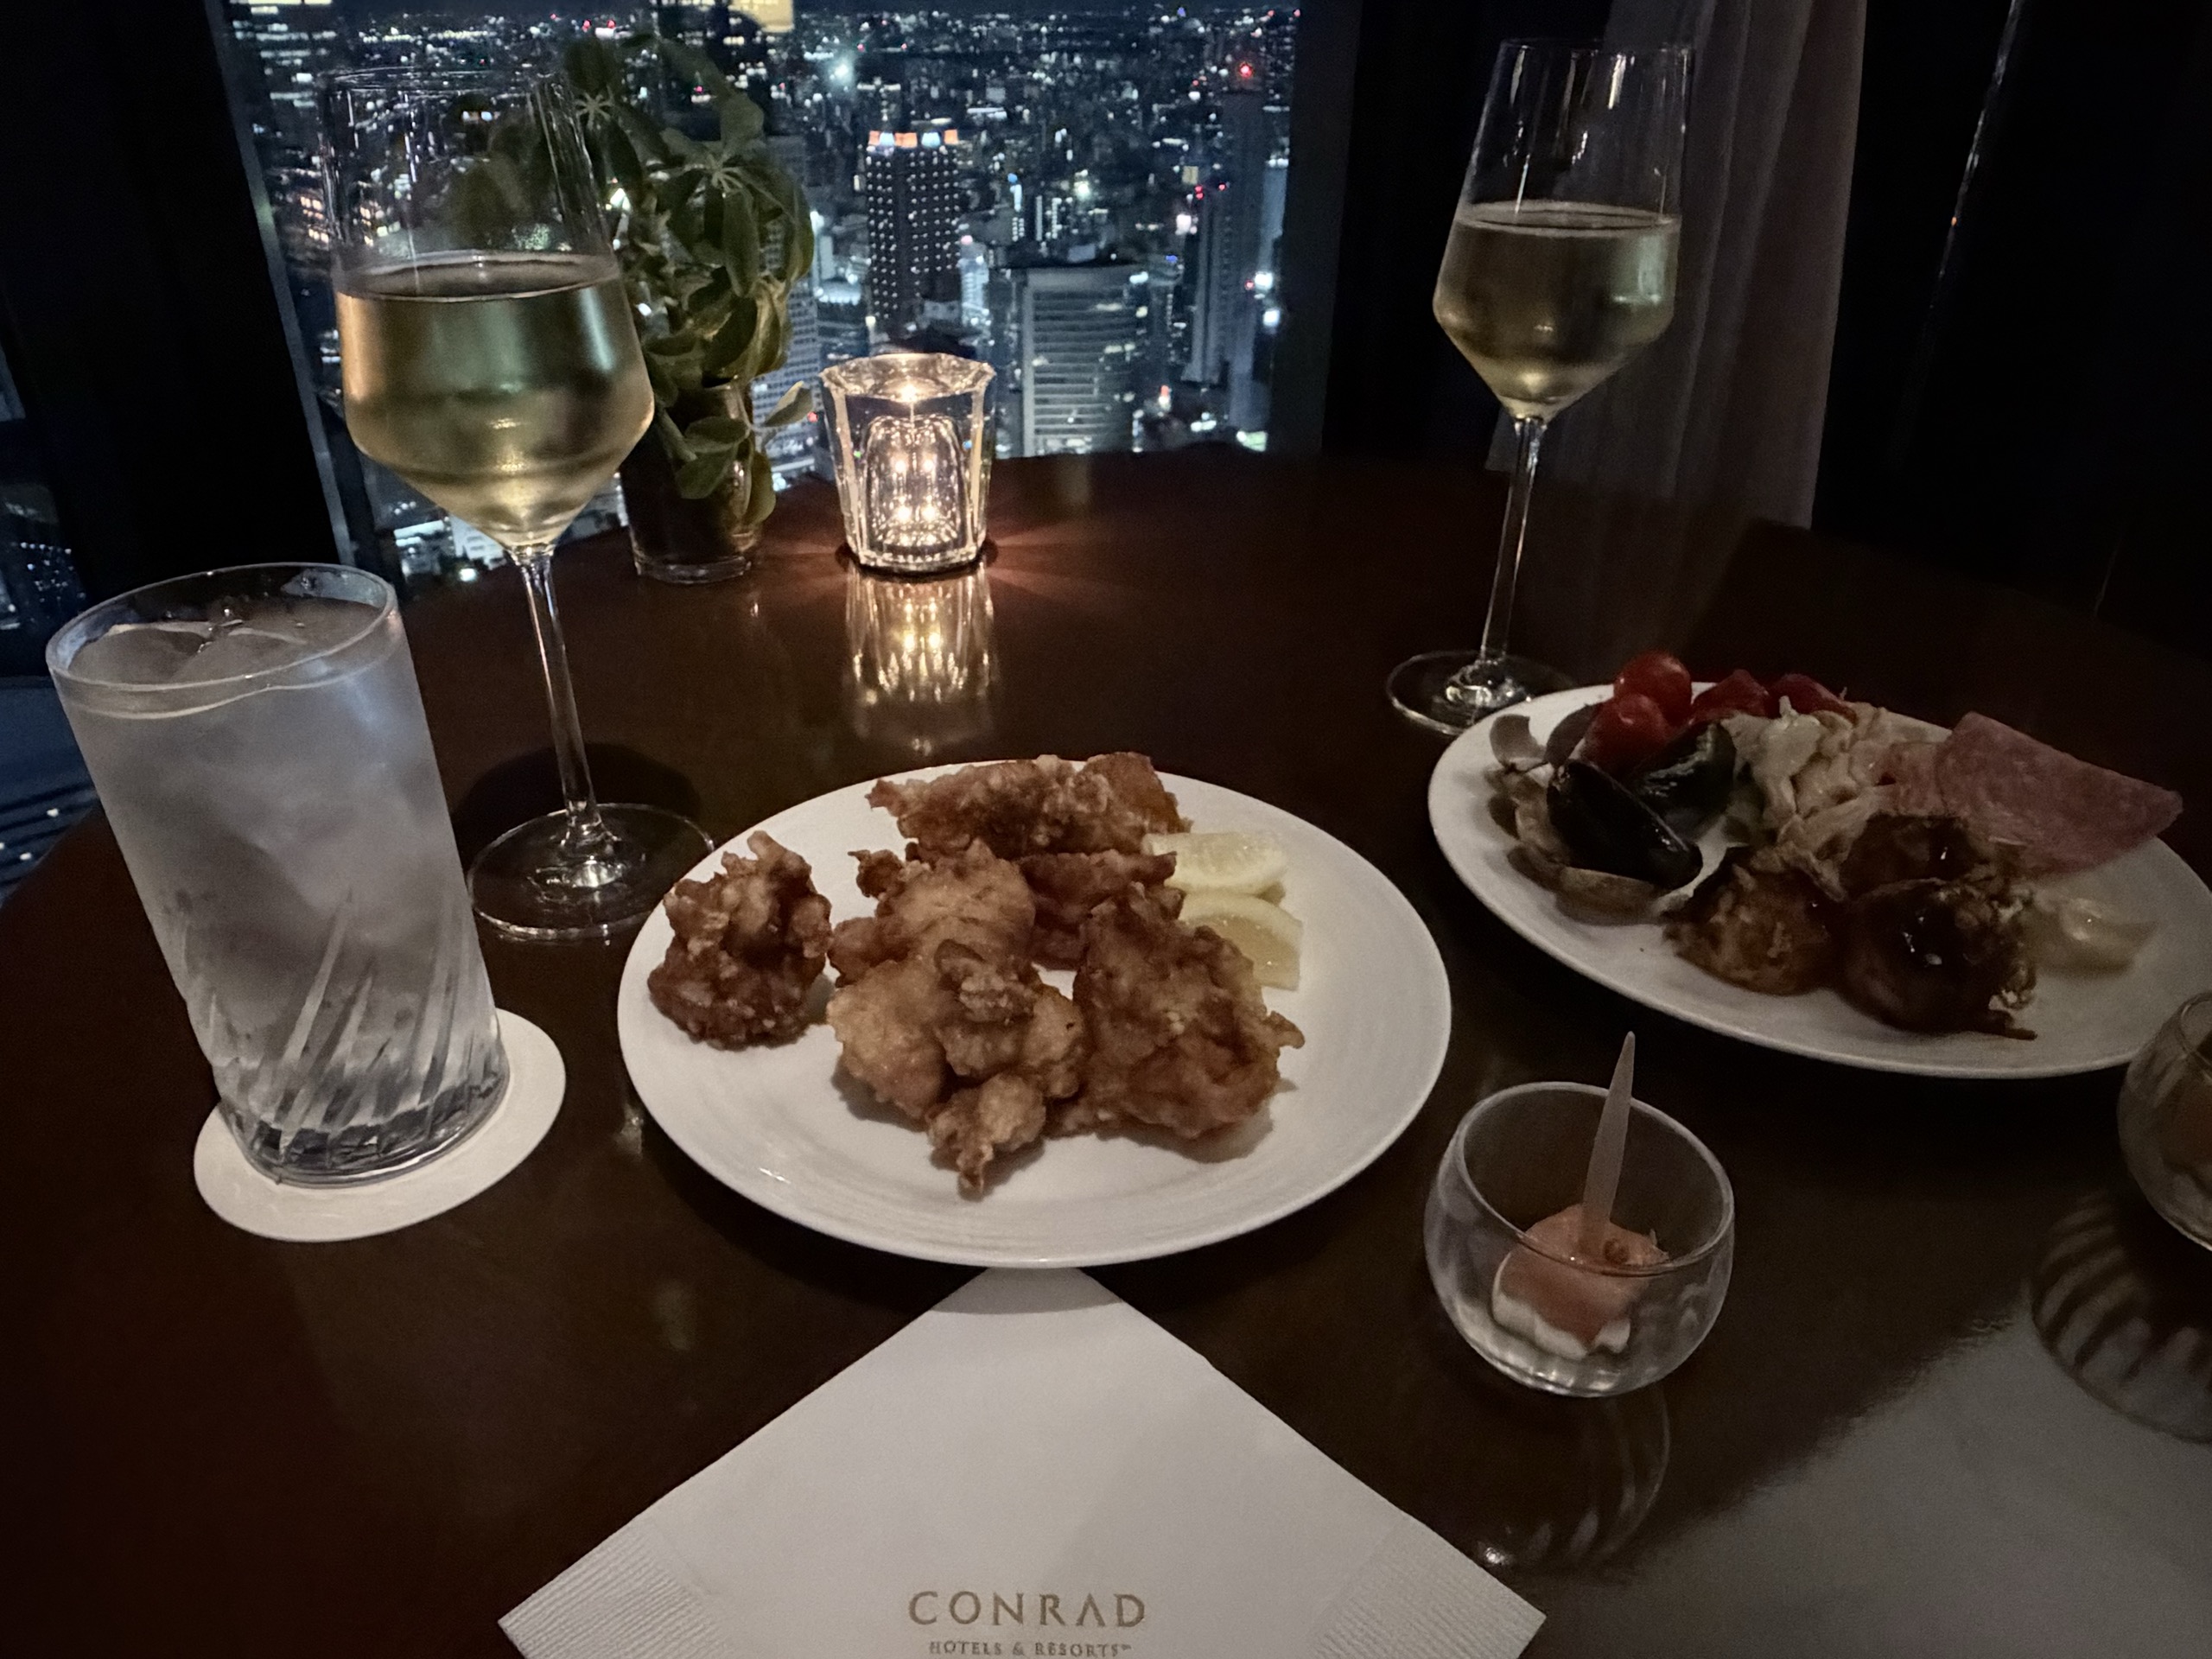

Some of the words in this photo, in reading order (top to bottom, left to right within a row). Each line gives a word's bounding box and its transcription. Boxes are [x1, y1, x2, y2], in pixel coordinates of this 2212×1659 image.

[908, 1591, 1146, 1628] CONRAD
[929, 1641, 1002, 1656] HOTELS
[1012, 1642, 1025, 1656] &
